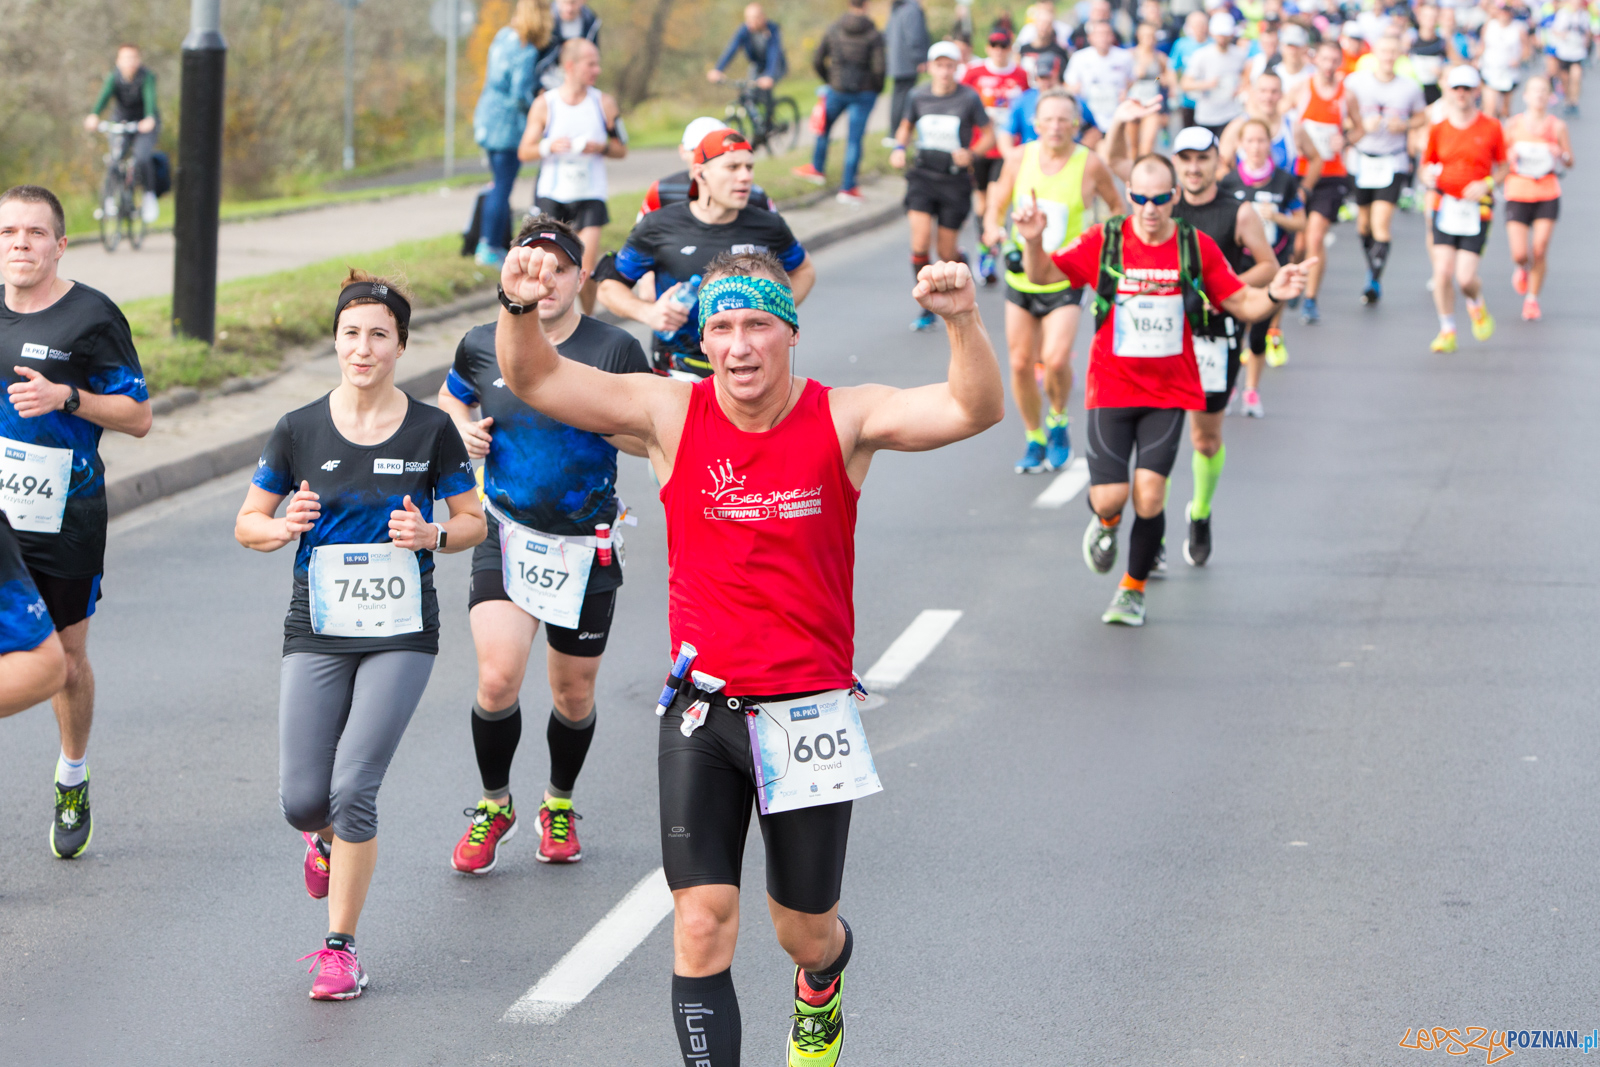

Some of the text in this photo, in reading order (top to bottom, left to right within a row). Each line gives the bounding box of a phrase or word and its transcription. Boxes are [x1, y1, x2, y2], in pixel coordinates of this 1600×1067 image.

[1133, 317, 1173, 332] 1843
[321, 460, 341, 472] 4F
[4, 494, 35, 505] Krzysztof
[722, 493, 762, 506] BIEG
[779, 499, 821, 512] PÓŁMARATON
[717, 509, 760, 518] TIPTOPOL
[780, 507, 822, 519] POBIEDZISKA
[518, 562, 570, 590] 1657
[335, 576, 405, 602] 7430
[794, 728, 850, 763] 605
[813, 761, 842, 771] Dawid
